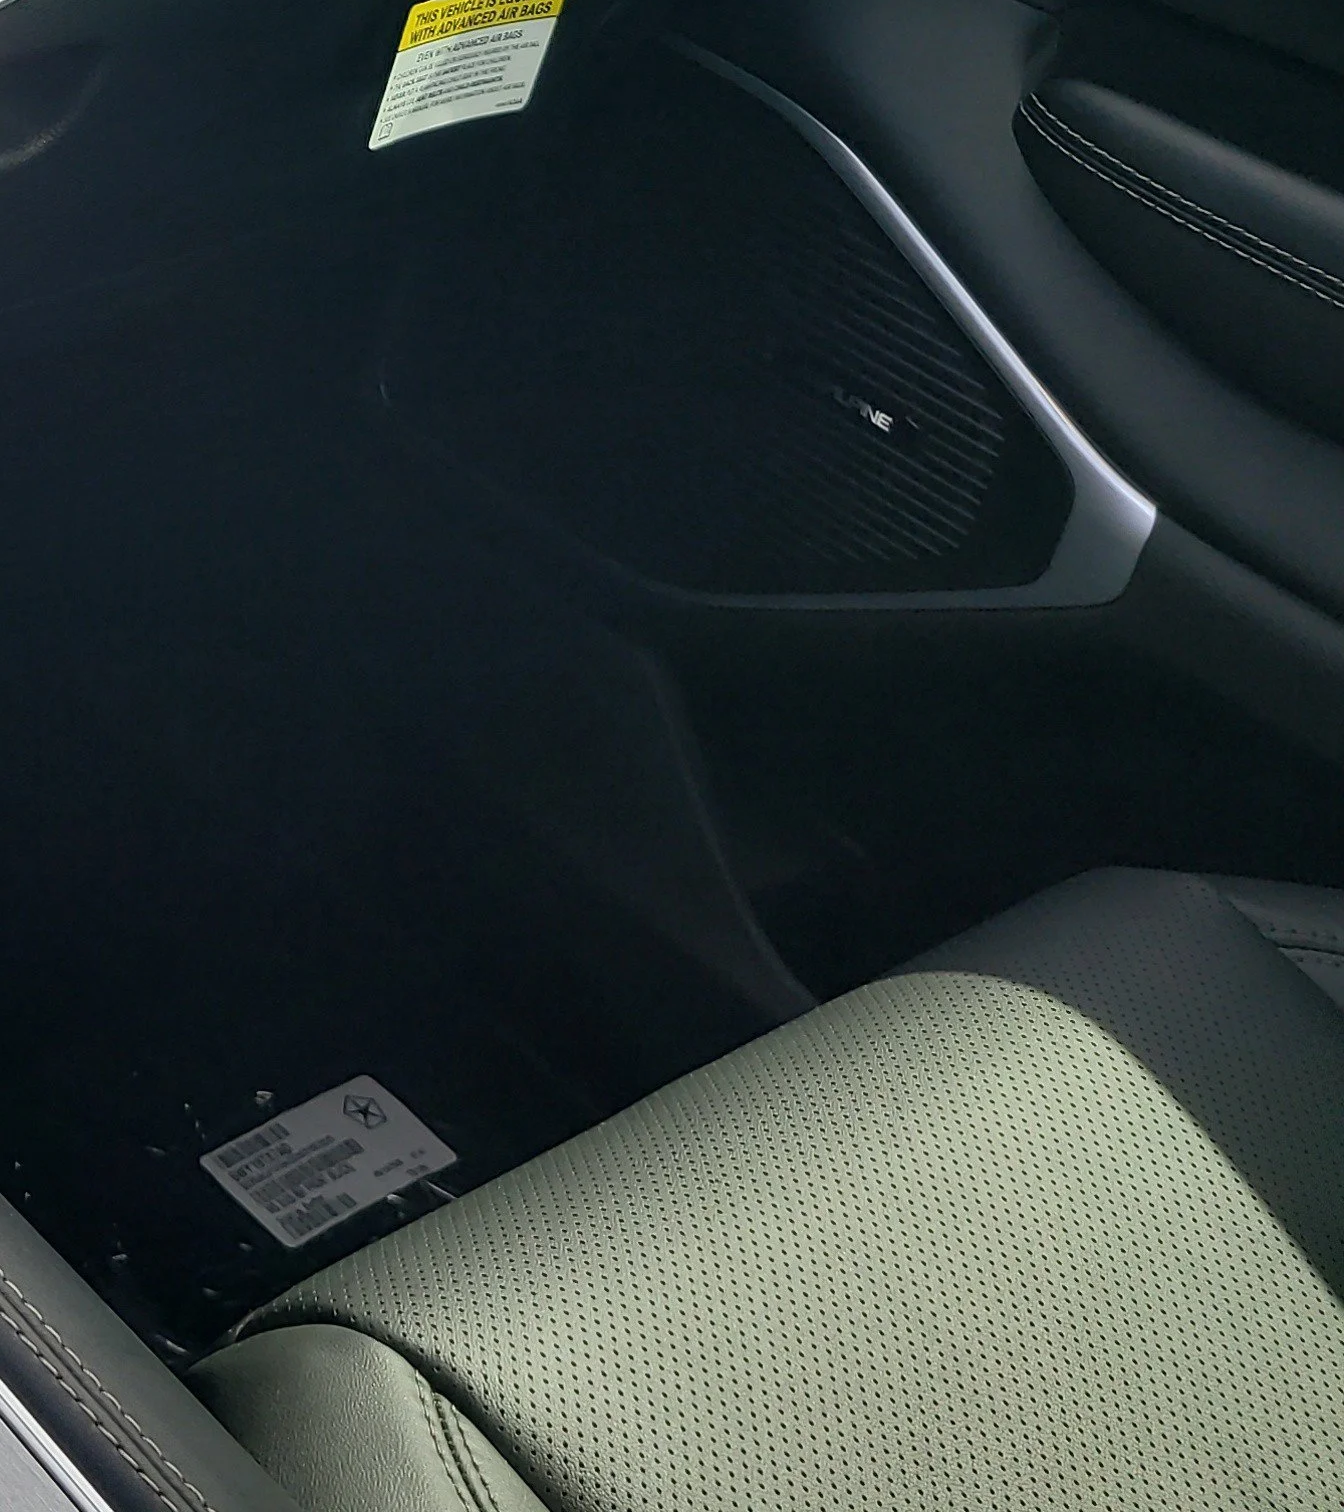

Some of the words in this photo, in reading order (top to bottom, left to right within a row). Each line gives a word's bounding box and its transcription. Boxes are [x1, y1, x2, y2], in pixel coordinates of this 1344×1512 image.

[410, 26, 435, 43] WITH
[437, 11, 497, 34] ADVANCED
[497, 7, 518, 21] AIR
[520, 1, 553, 16] BAGS
[416, 9, 440, 26] THIS
